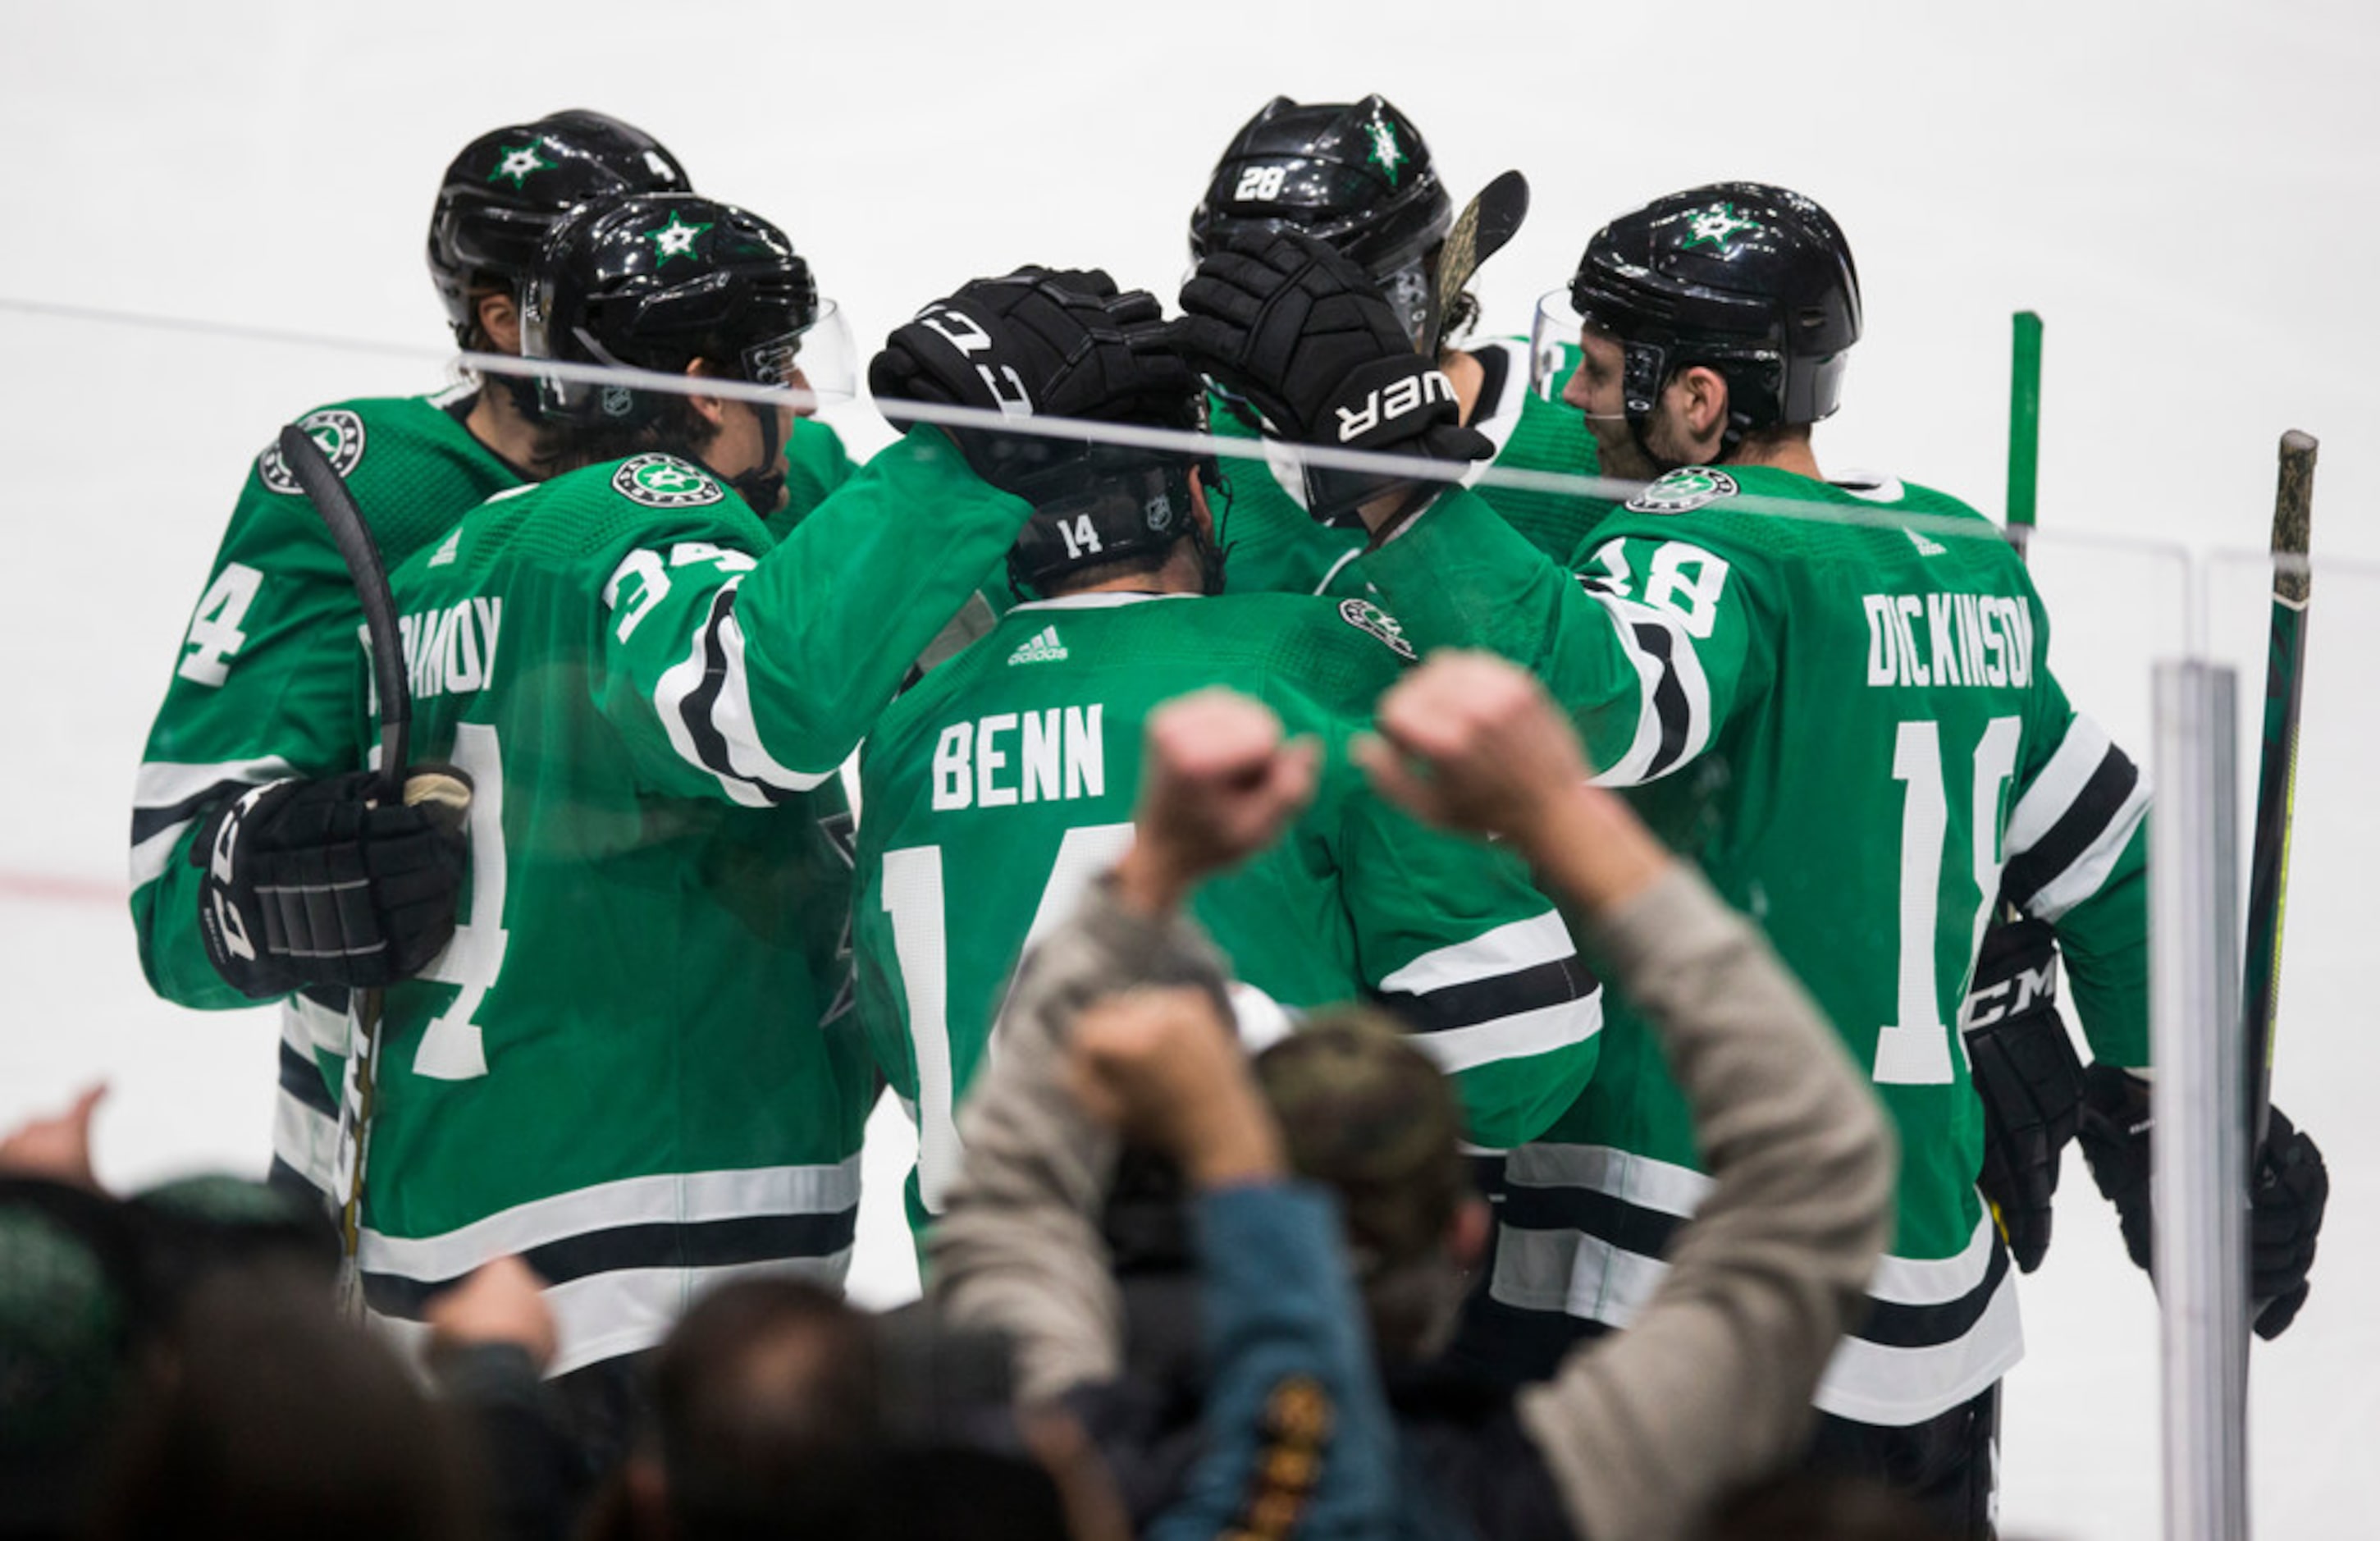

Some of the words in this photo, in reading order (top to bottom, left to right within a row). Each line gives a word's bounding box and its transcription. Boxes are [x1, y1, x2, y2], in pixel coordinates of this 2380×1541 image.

[1234, 167, 1286, 201] 28
[916, 304, 1034, 422] CC
[1335, 370, 1460, 443] UER
[1057, 512, 1103, 560] 14
[177, 561, 264, 688] 4
[602, 542, 758, 645] 34
[1007, 647, 1069, 666] adidas
[932, 702, 1104, 812] BENN
[1962, 953, 2058, 1034] CM
